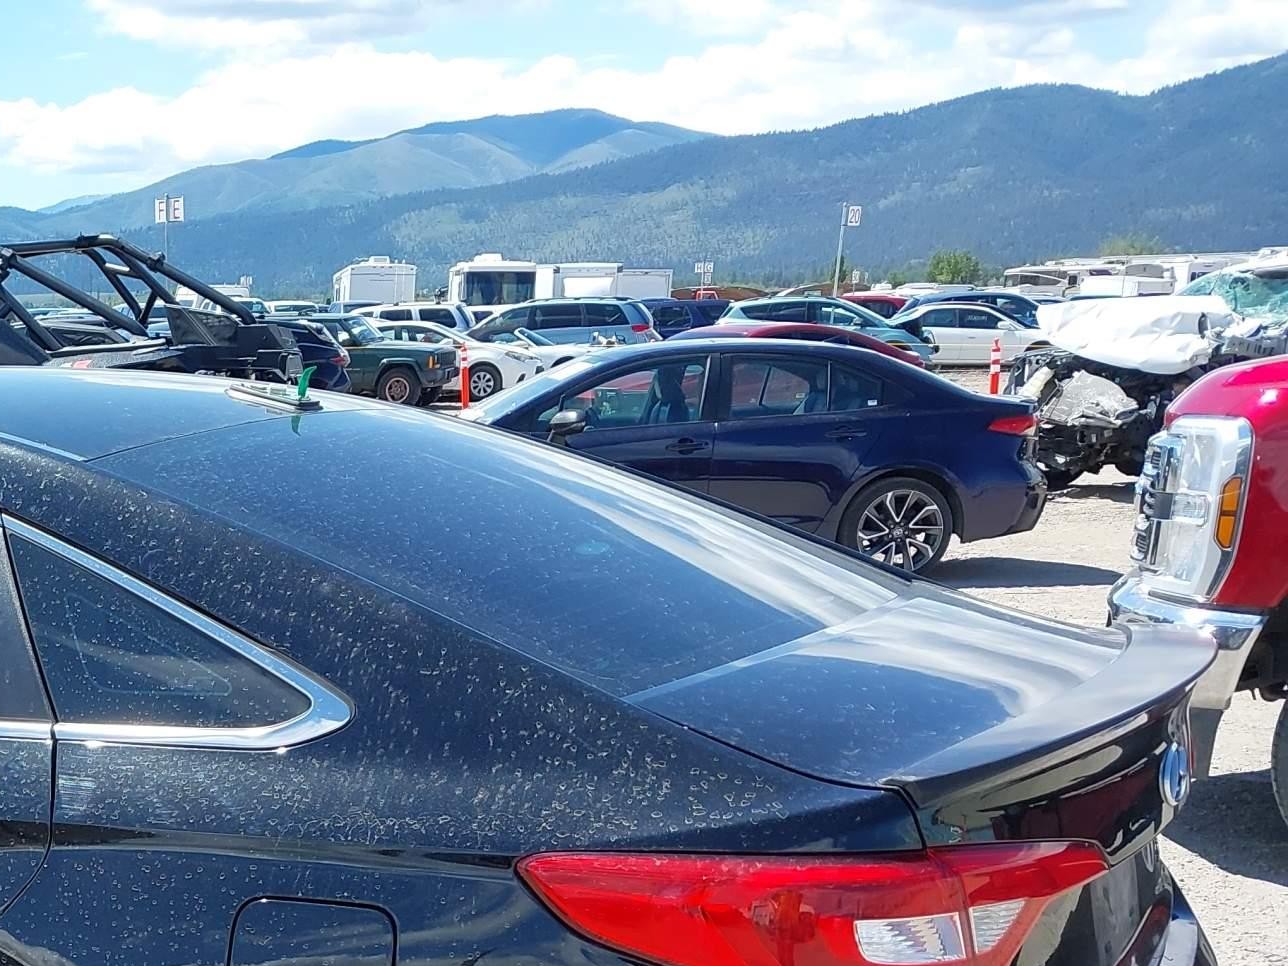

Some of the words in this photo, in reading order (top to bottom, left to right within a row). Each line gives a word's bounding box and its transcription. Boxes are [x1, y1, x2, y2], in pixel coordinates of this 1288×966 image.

[158, 200, 165, 221] F
[173, 199, 181, 220] E
[848, 208, 861, 224] 20
